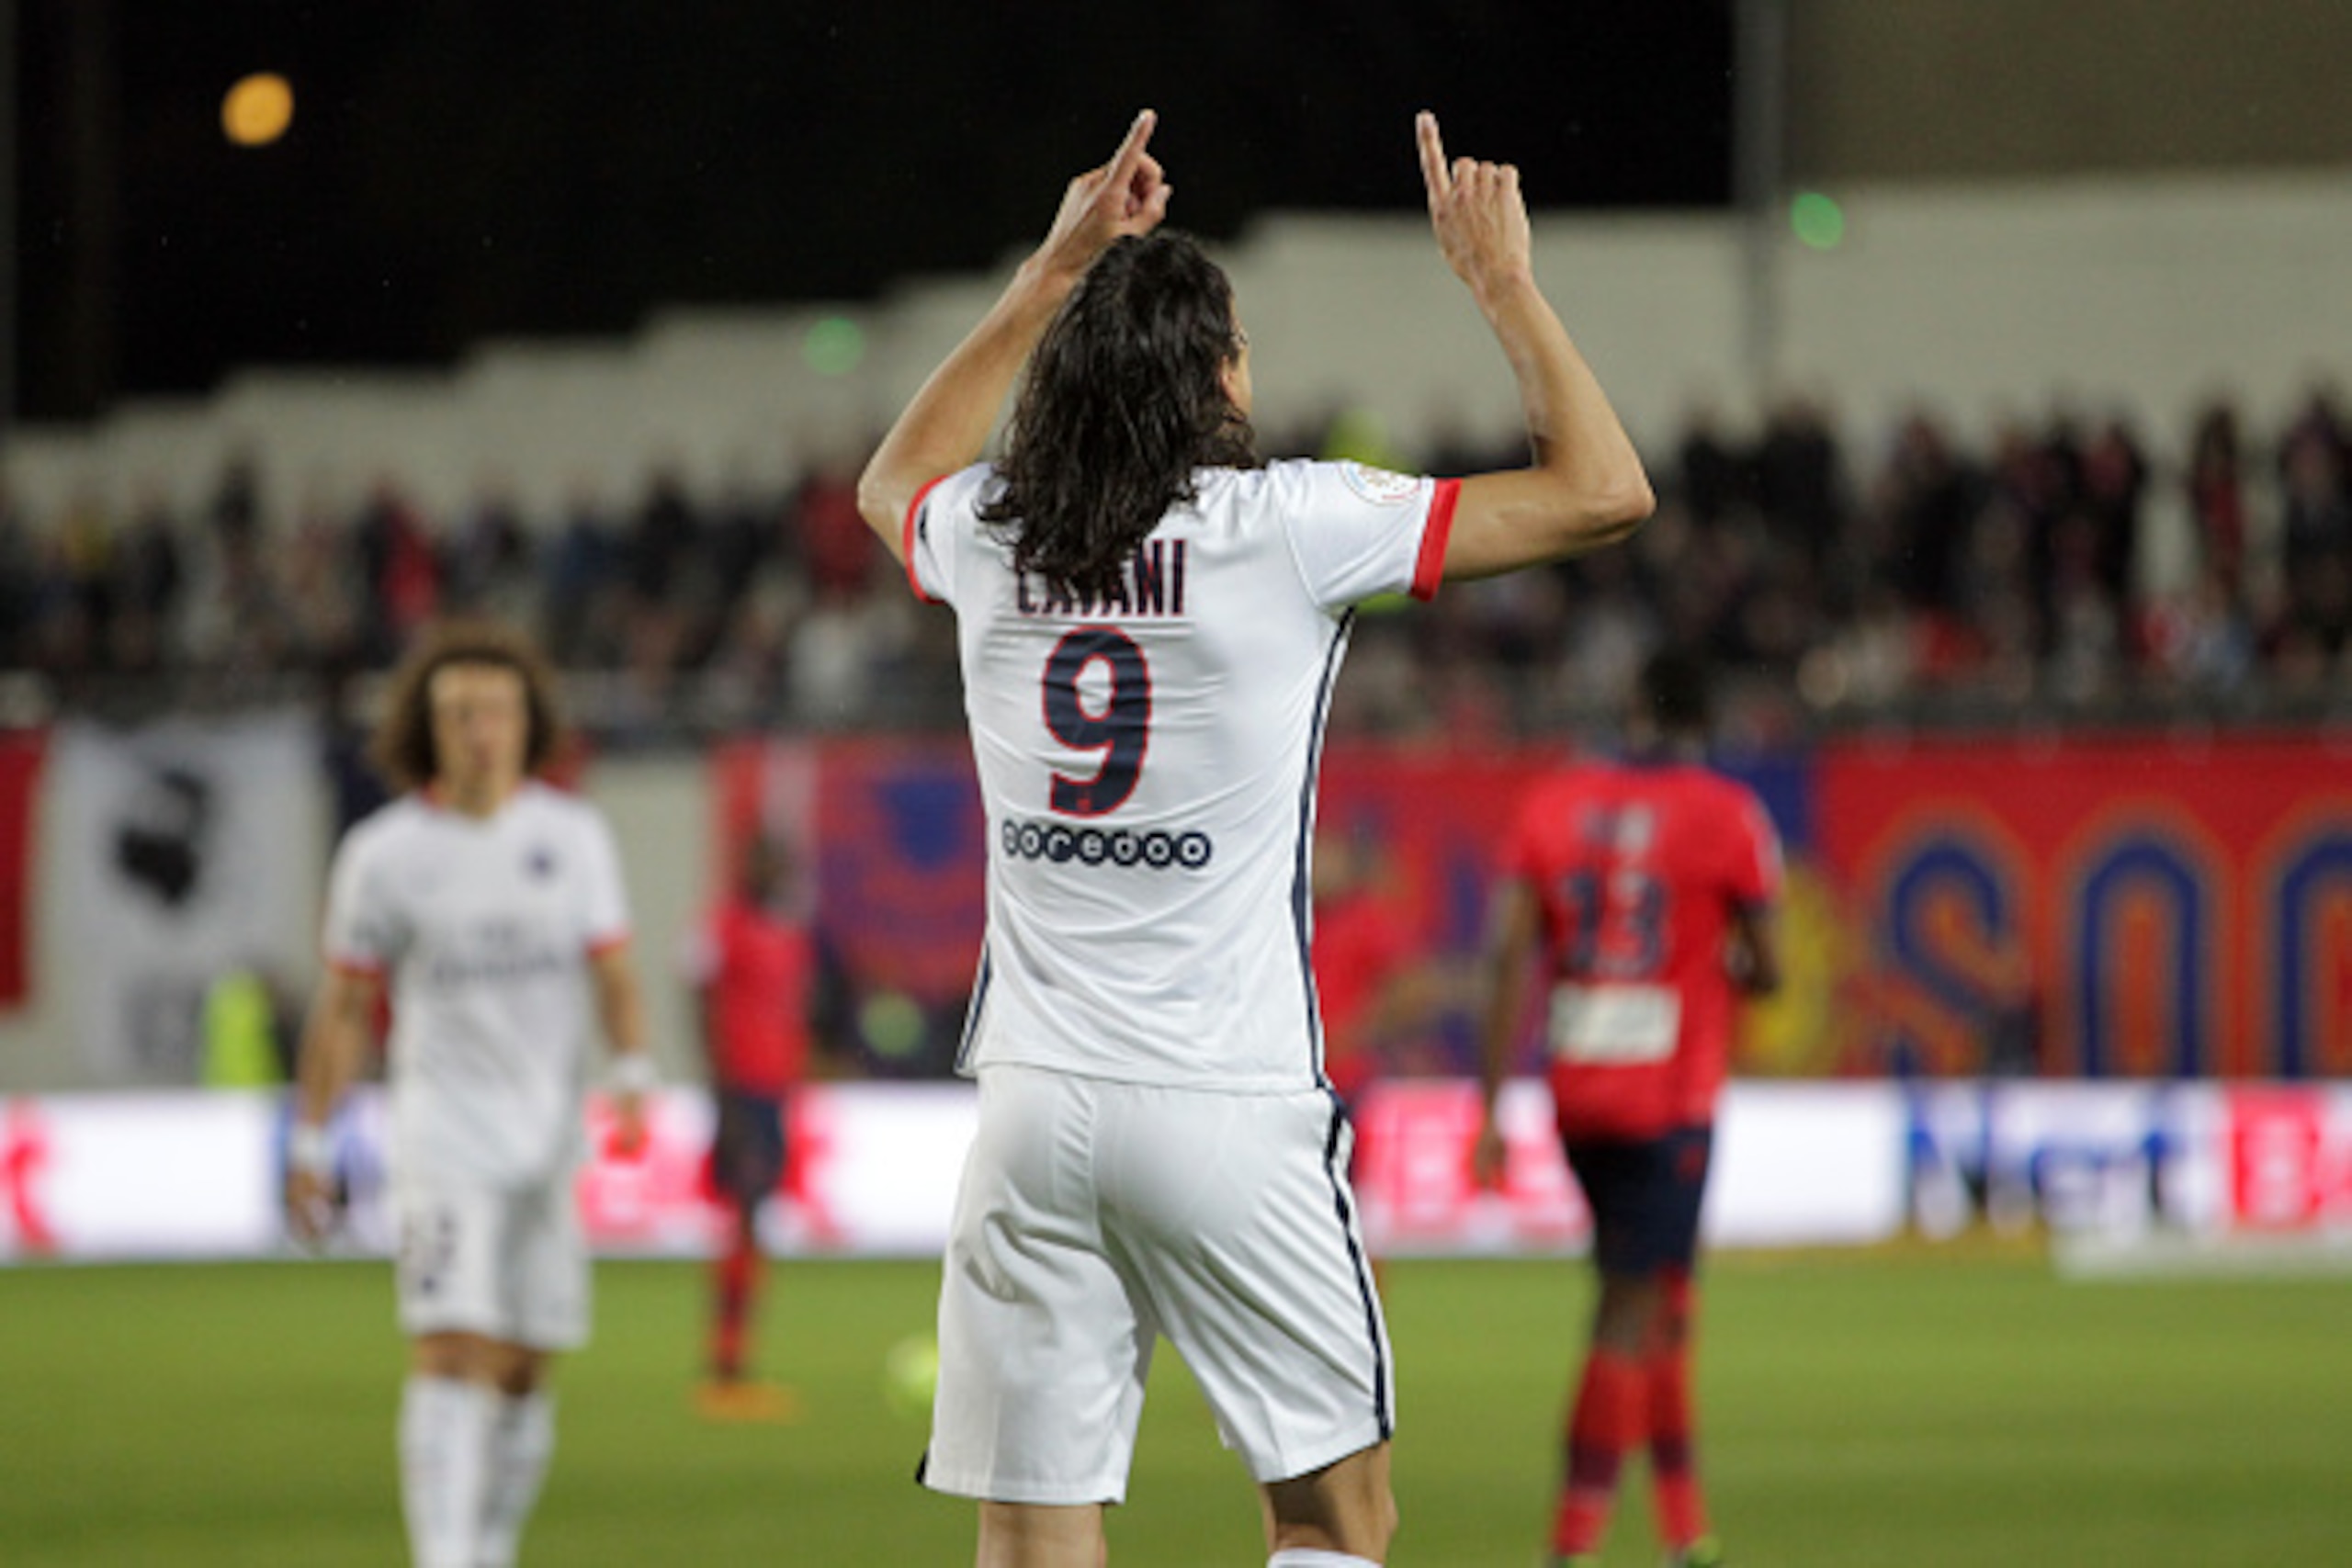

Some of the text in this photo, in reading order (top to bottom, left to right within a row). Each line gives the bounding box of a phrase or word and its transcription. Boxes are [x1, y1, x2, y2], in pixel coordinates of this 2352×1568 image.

[1042, 624, 1152, 818] 9
[1001, 819, 1212, 870] ooredoo
[1555, 869, 1676, 979] 13
